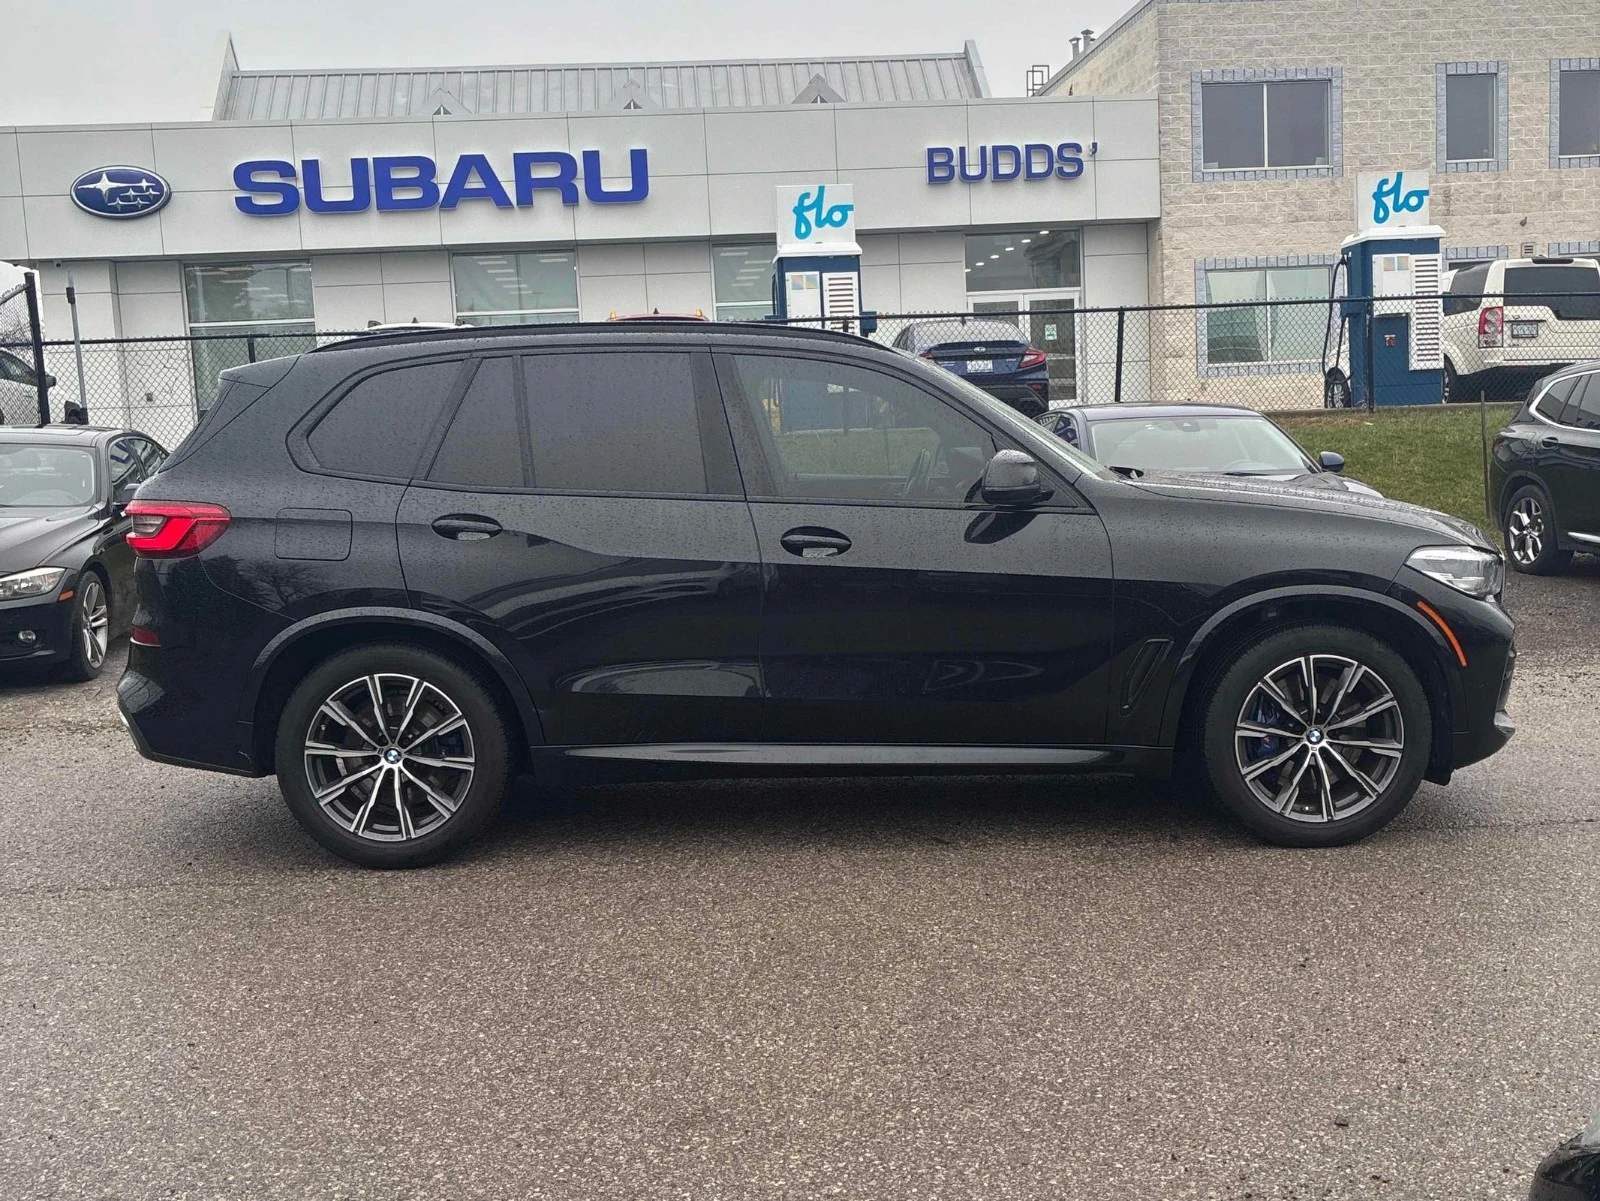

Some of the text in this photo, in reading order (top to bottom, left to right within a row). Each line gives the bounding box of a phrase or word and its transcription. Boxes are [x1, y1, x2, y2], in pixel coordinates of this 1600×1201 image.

[234, 149, 649, 215] SUBARU
[927, 141, 1098, 183] BUDDS'
[793, 185, 854, 240] flo
[1372, 171, 1430, 224] flo
